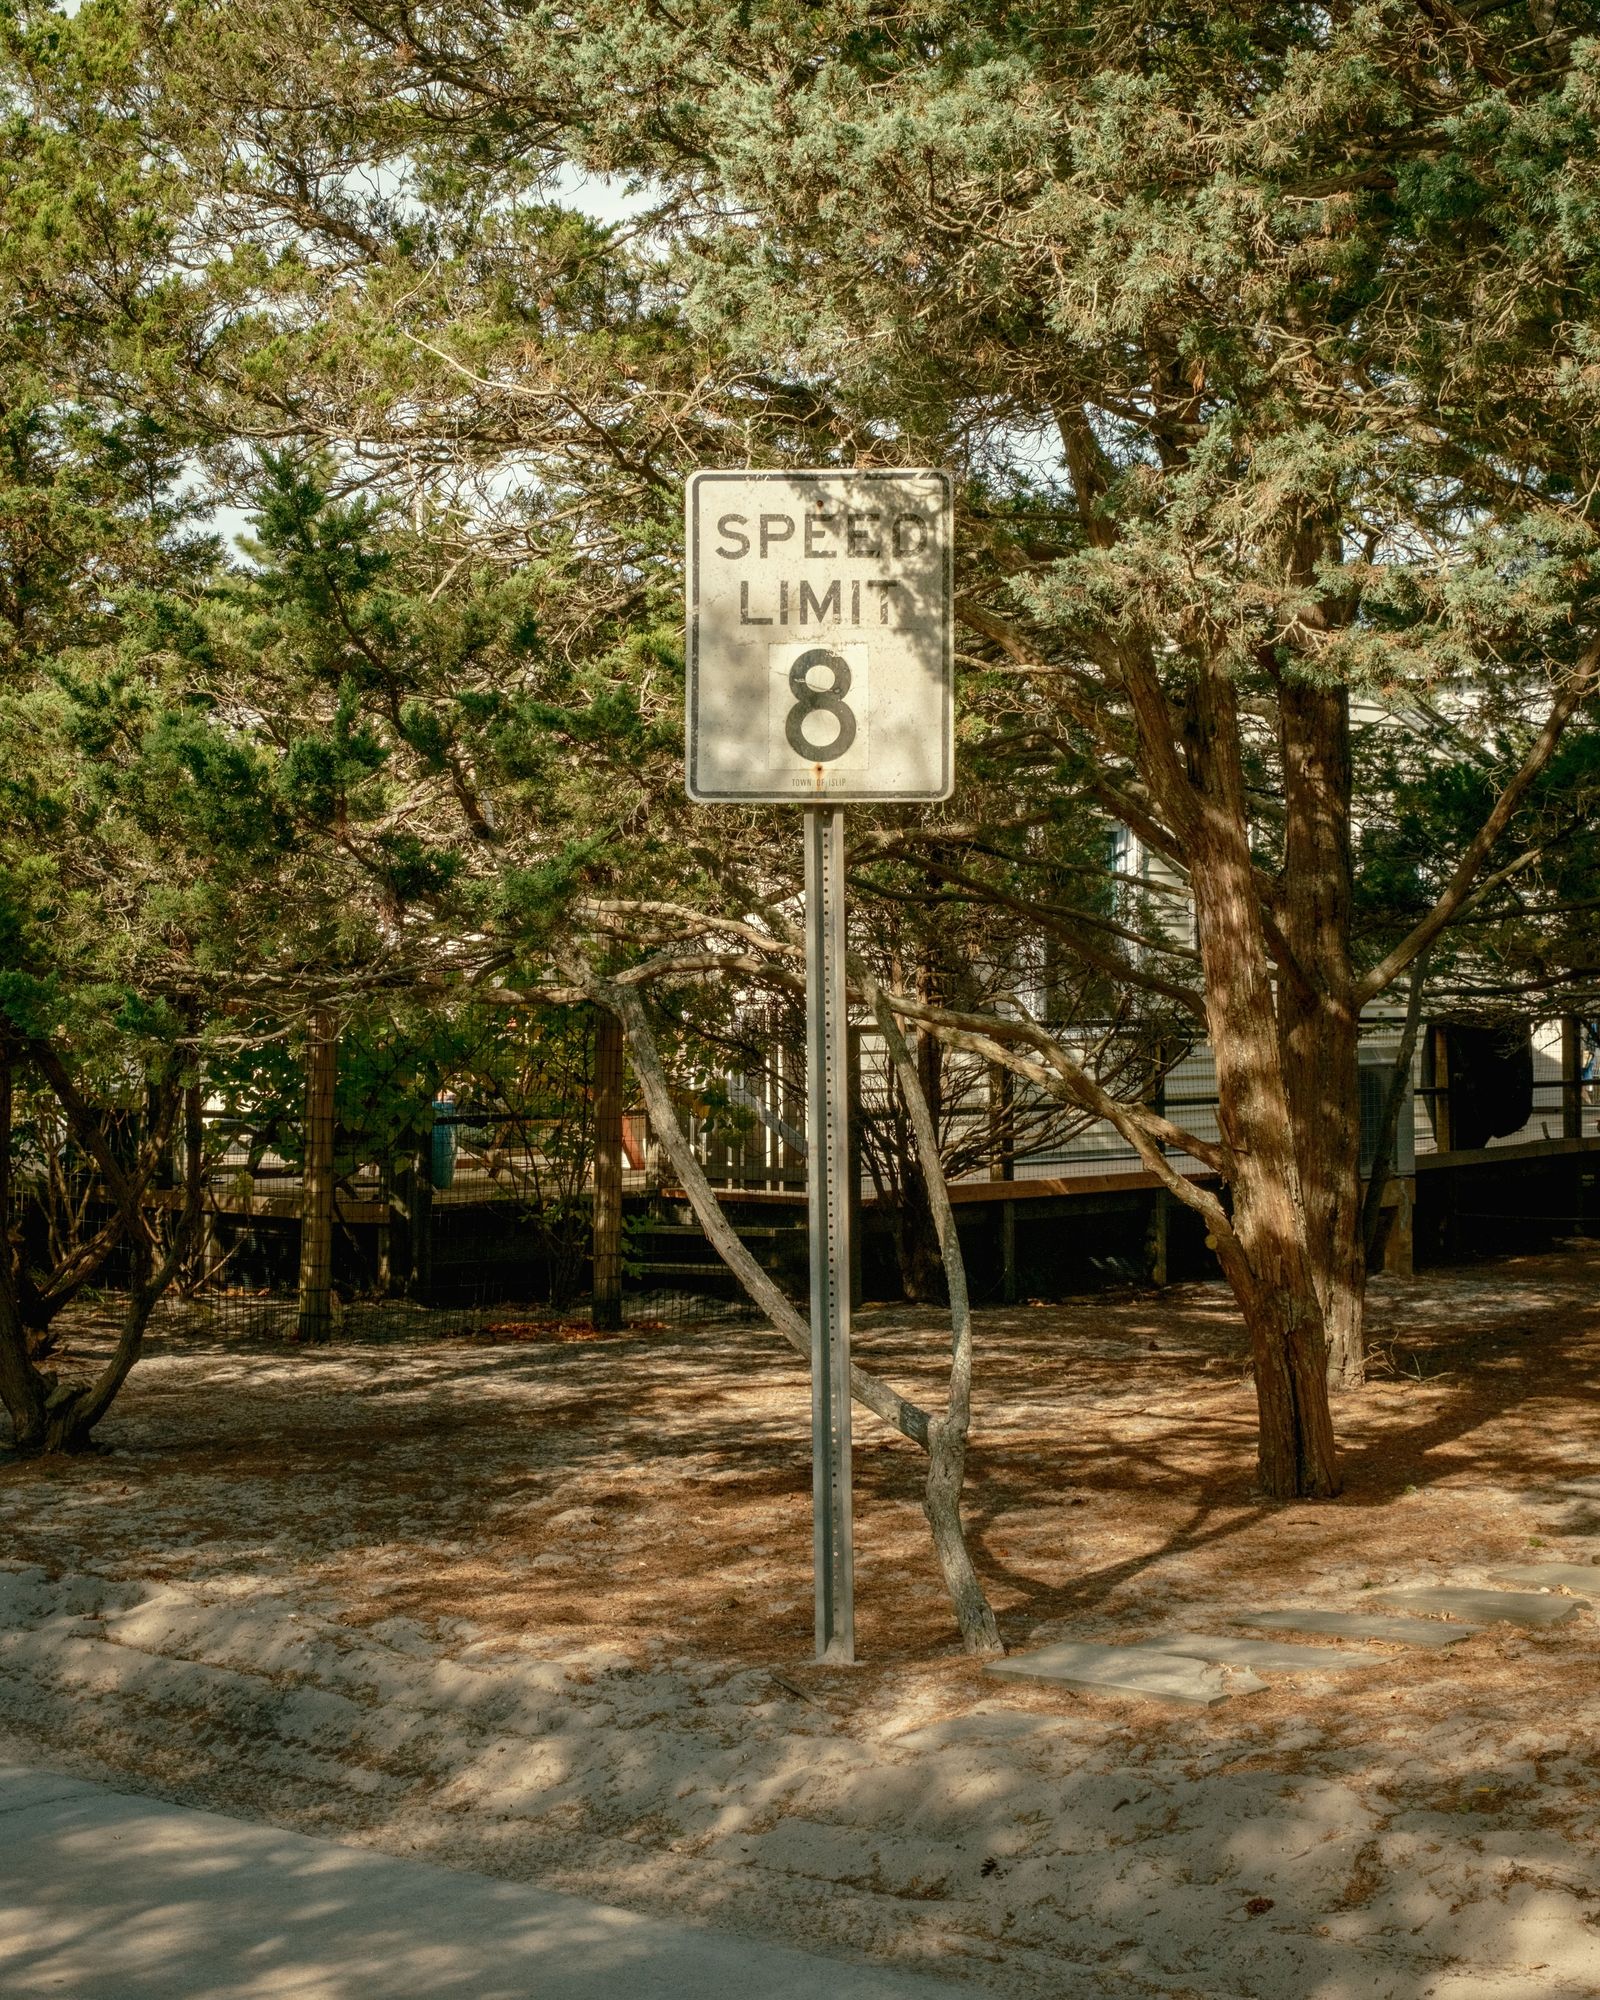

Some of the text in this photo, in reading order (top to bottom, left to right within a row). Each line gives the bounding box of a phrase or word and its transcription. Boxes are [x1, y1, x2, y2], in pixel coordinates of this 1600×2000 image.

[715, 513, 928, 560] SPEED
[739, 579, 901, 626] LIMIT
[785, 648, 857, 762] 8
[791, 778, 846, 787] TOWN OF ISLIP
